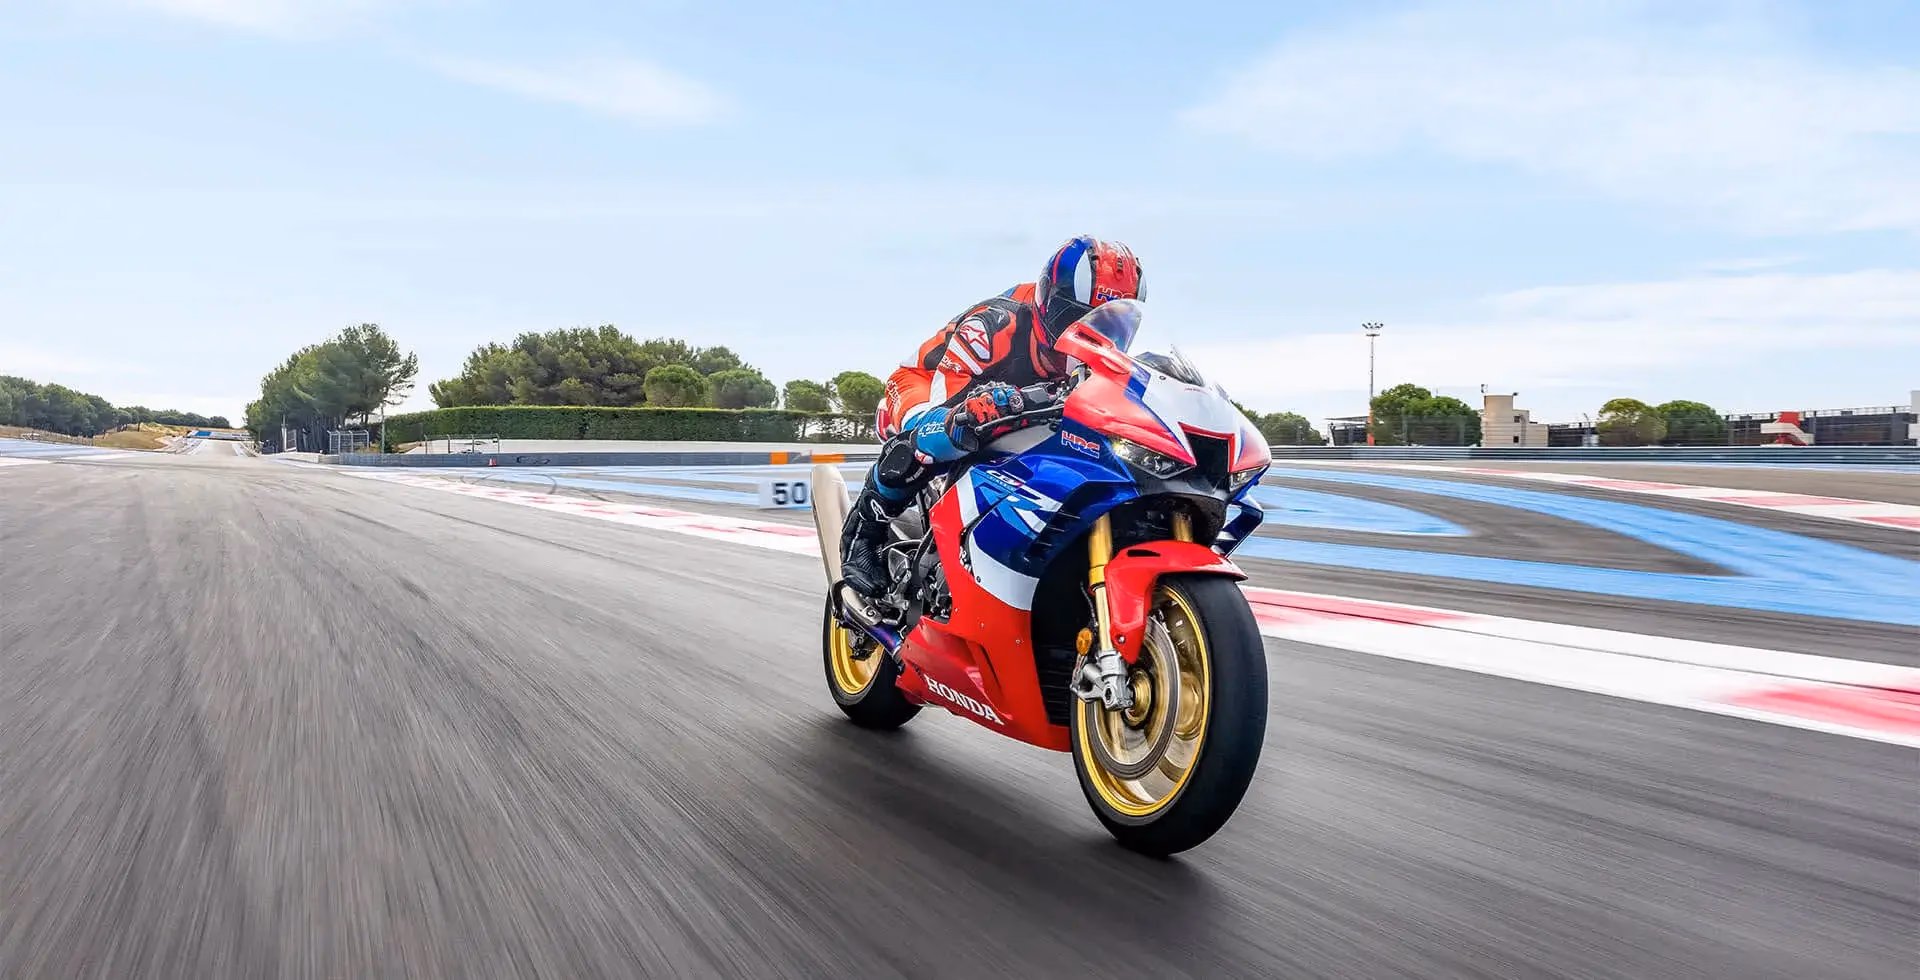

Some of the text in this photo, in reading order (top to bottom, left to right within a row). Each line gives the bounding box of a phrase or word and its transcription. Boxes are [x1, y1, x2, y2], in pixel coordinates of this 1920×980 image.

[1061, 430, 1100, 459] HRC
[772, 482, 808, 505] 50
[923, 673, 1005, 725] HONDA
